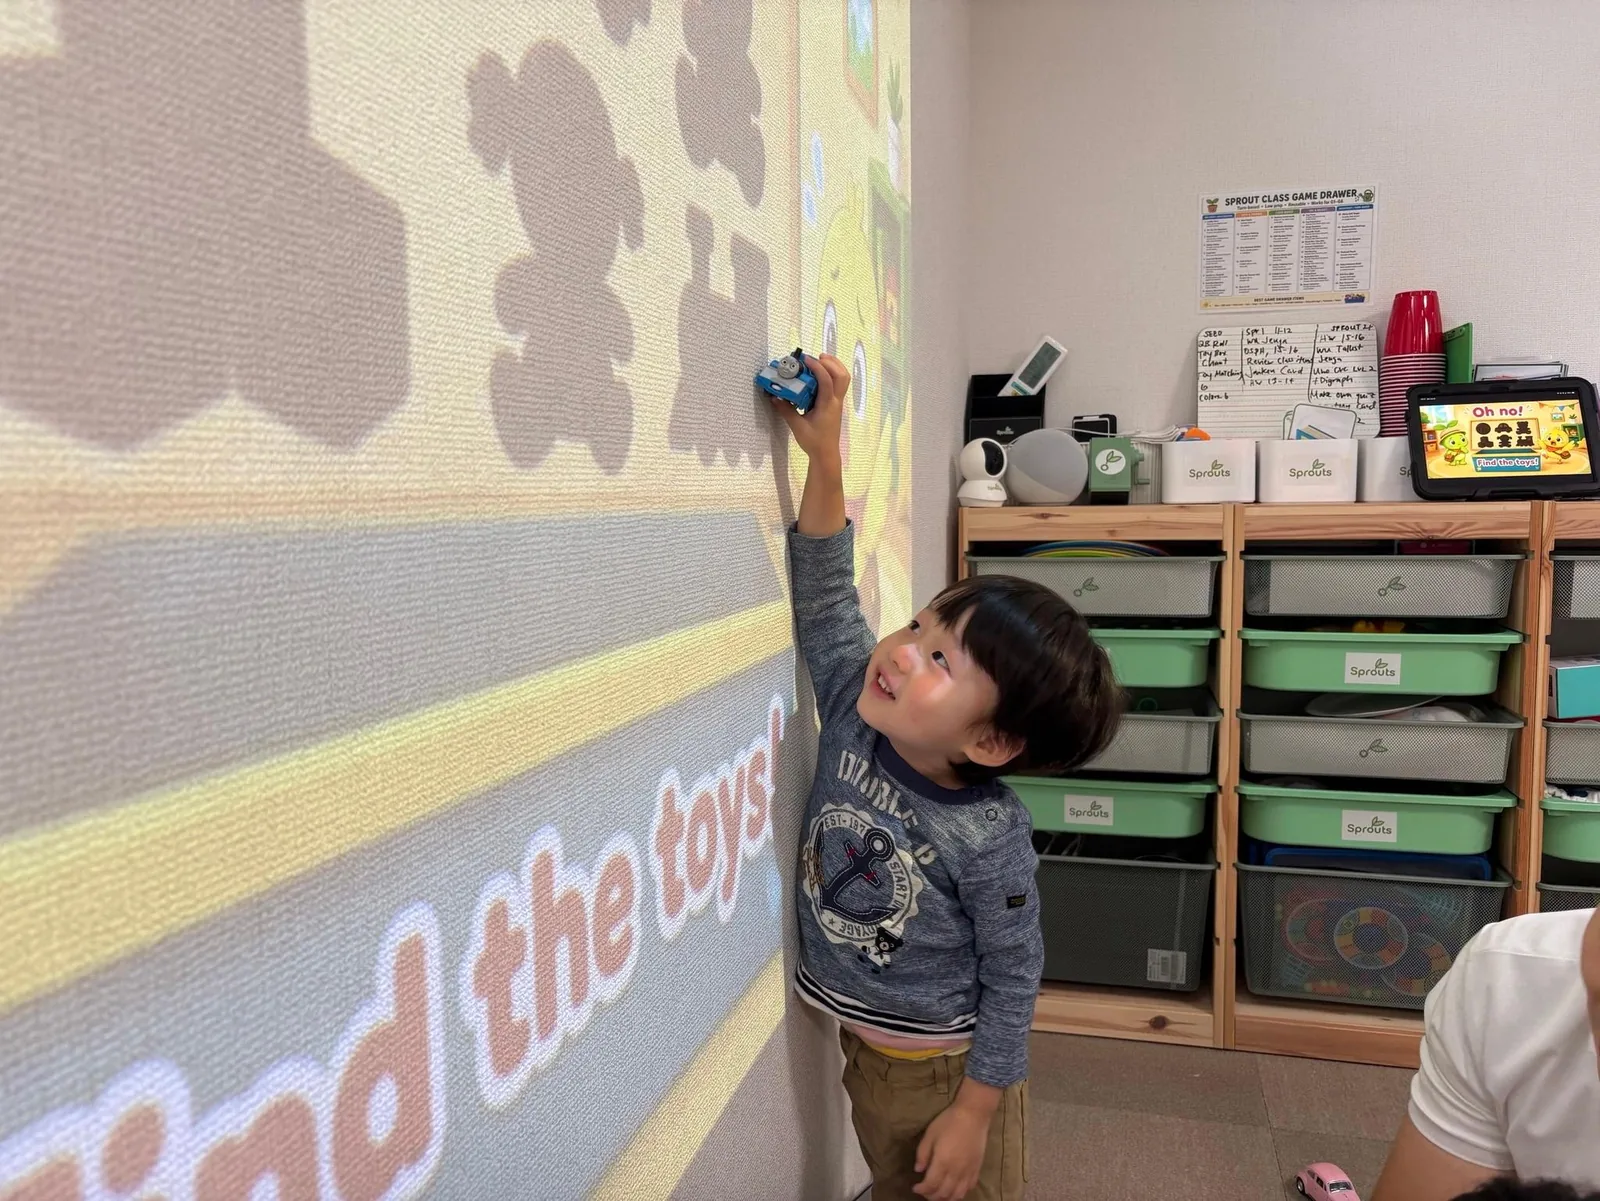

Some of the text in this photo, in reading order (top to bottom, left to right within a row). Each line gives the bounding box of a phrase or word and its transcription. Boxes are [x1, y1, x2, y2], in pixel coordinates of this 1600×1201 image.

[1225, 189, 1358, 206] SPROUT CLASS GAME DRAWER
[1331, 323, 1361, 331] SPROUT
[1341, 334, 1366, 343] 15-16
[1472, 405, 1523, 418] Oh no!
[1499, 459, 1514, 467] the
[1516, 458, 1539, 468] toys!
[1188, 468, 1231, 480] Sprouts
[1289, 467, 1332, 479] Sprouts
[1350, 665, 1396, 679] Sprouts
[1068, 806, 1110, 820] Sprouts
[1346, 823, 1393, 837] Sprouts
[889, 861, 908, 902] START
[839, 921, 879, 938] OYAGE
[470, 846, 637, 1082] the
